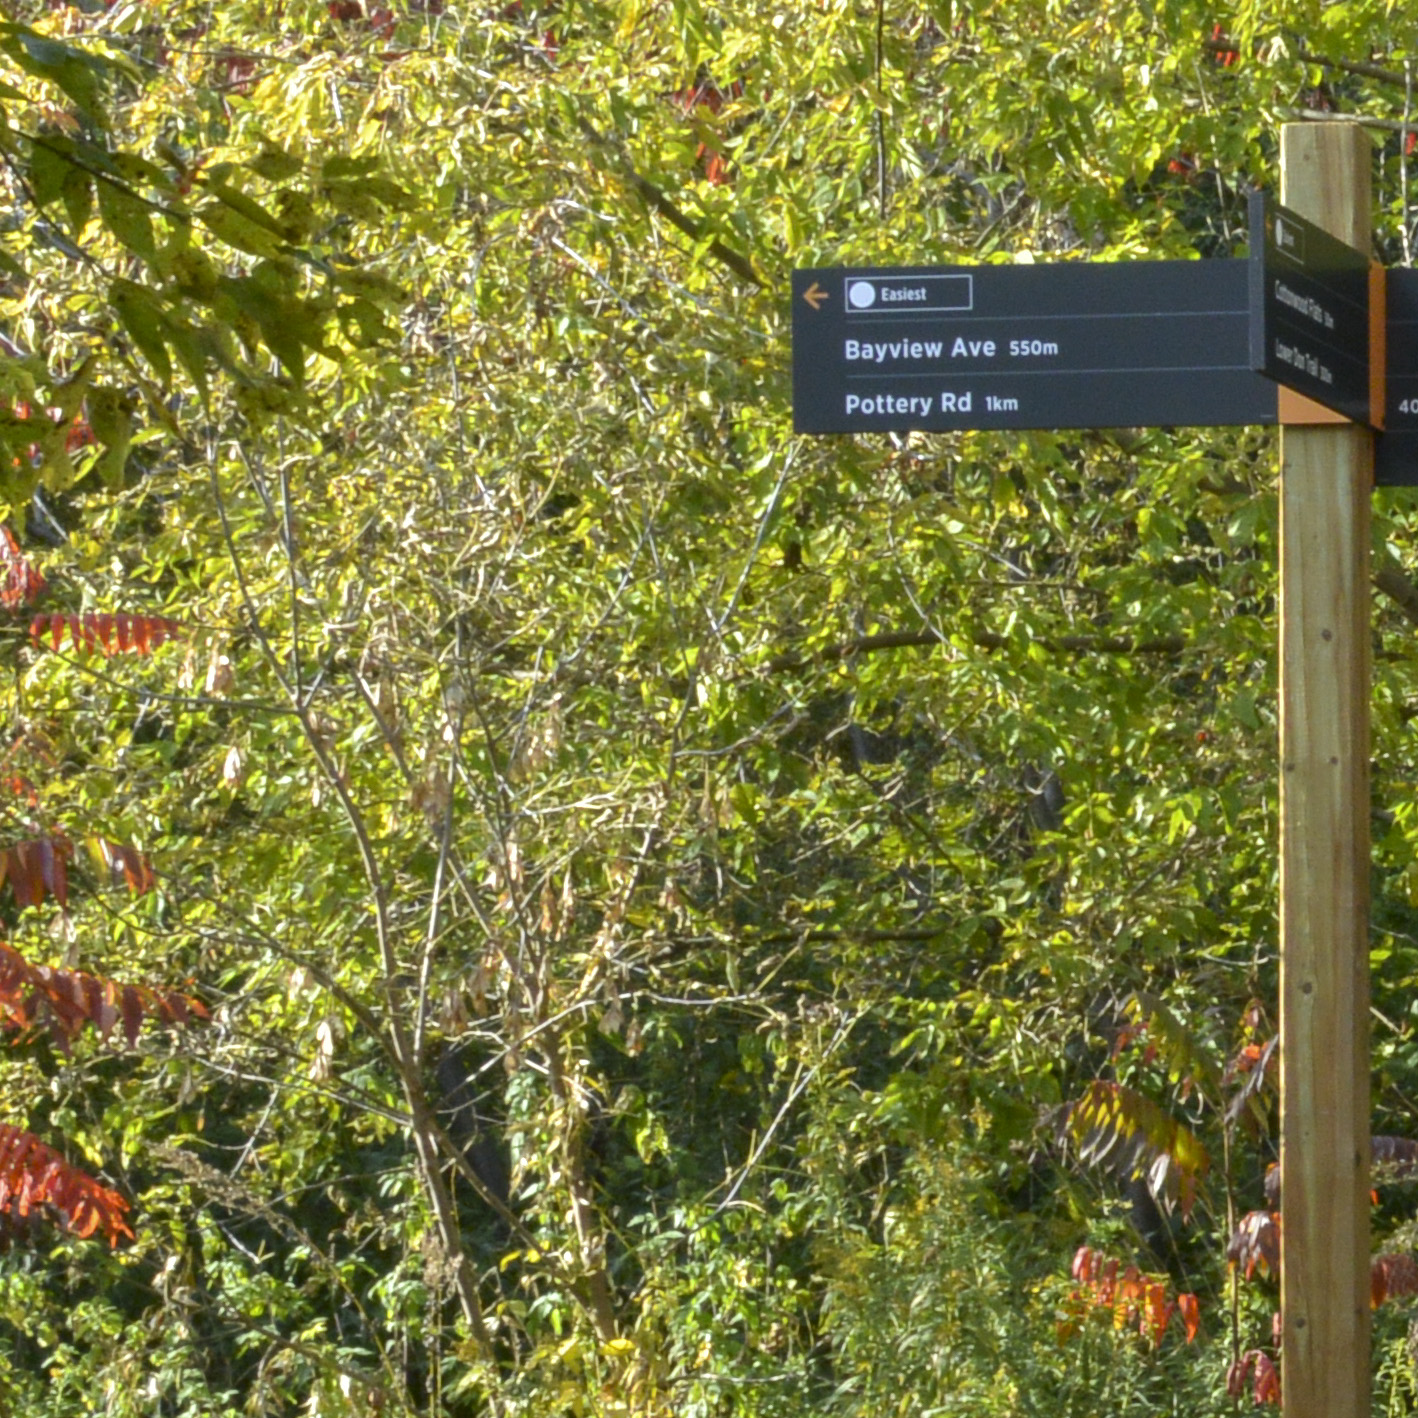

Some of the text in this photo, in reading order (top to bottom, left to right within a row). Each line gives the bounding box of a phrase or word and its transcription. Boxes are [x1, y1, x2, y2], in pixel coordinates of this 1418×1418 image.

[881, 286, 926, 302] Easiest
[845, 337, 1058, 361] Bayview Ave 550m
[845, 393, 1018, 416] Pottery Rd 1km
